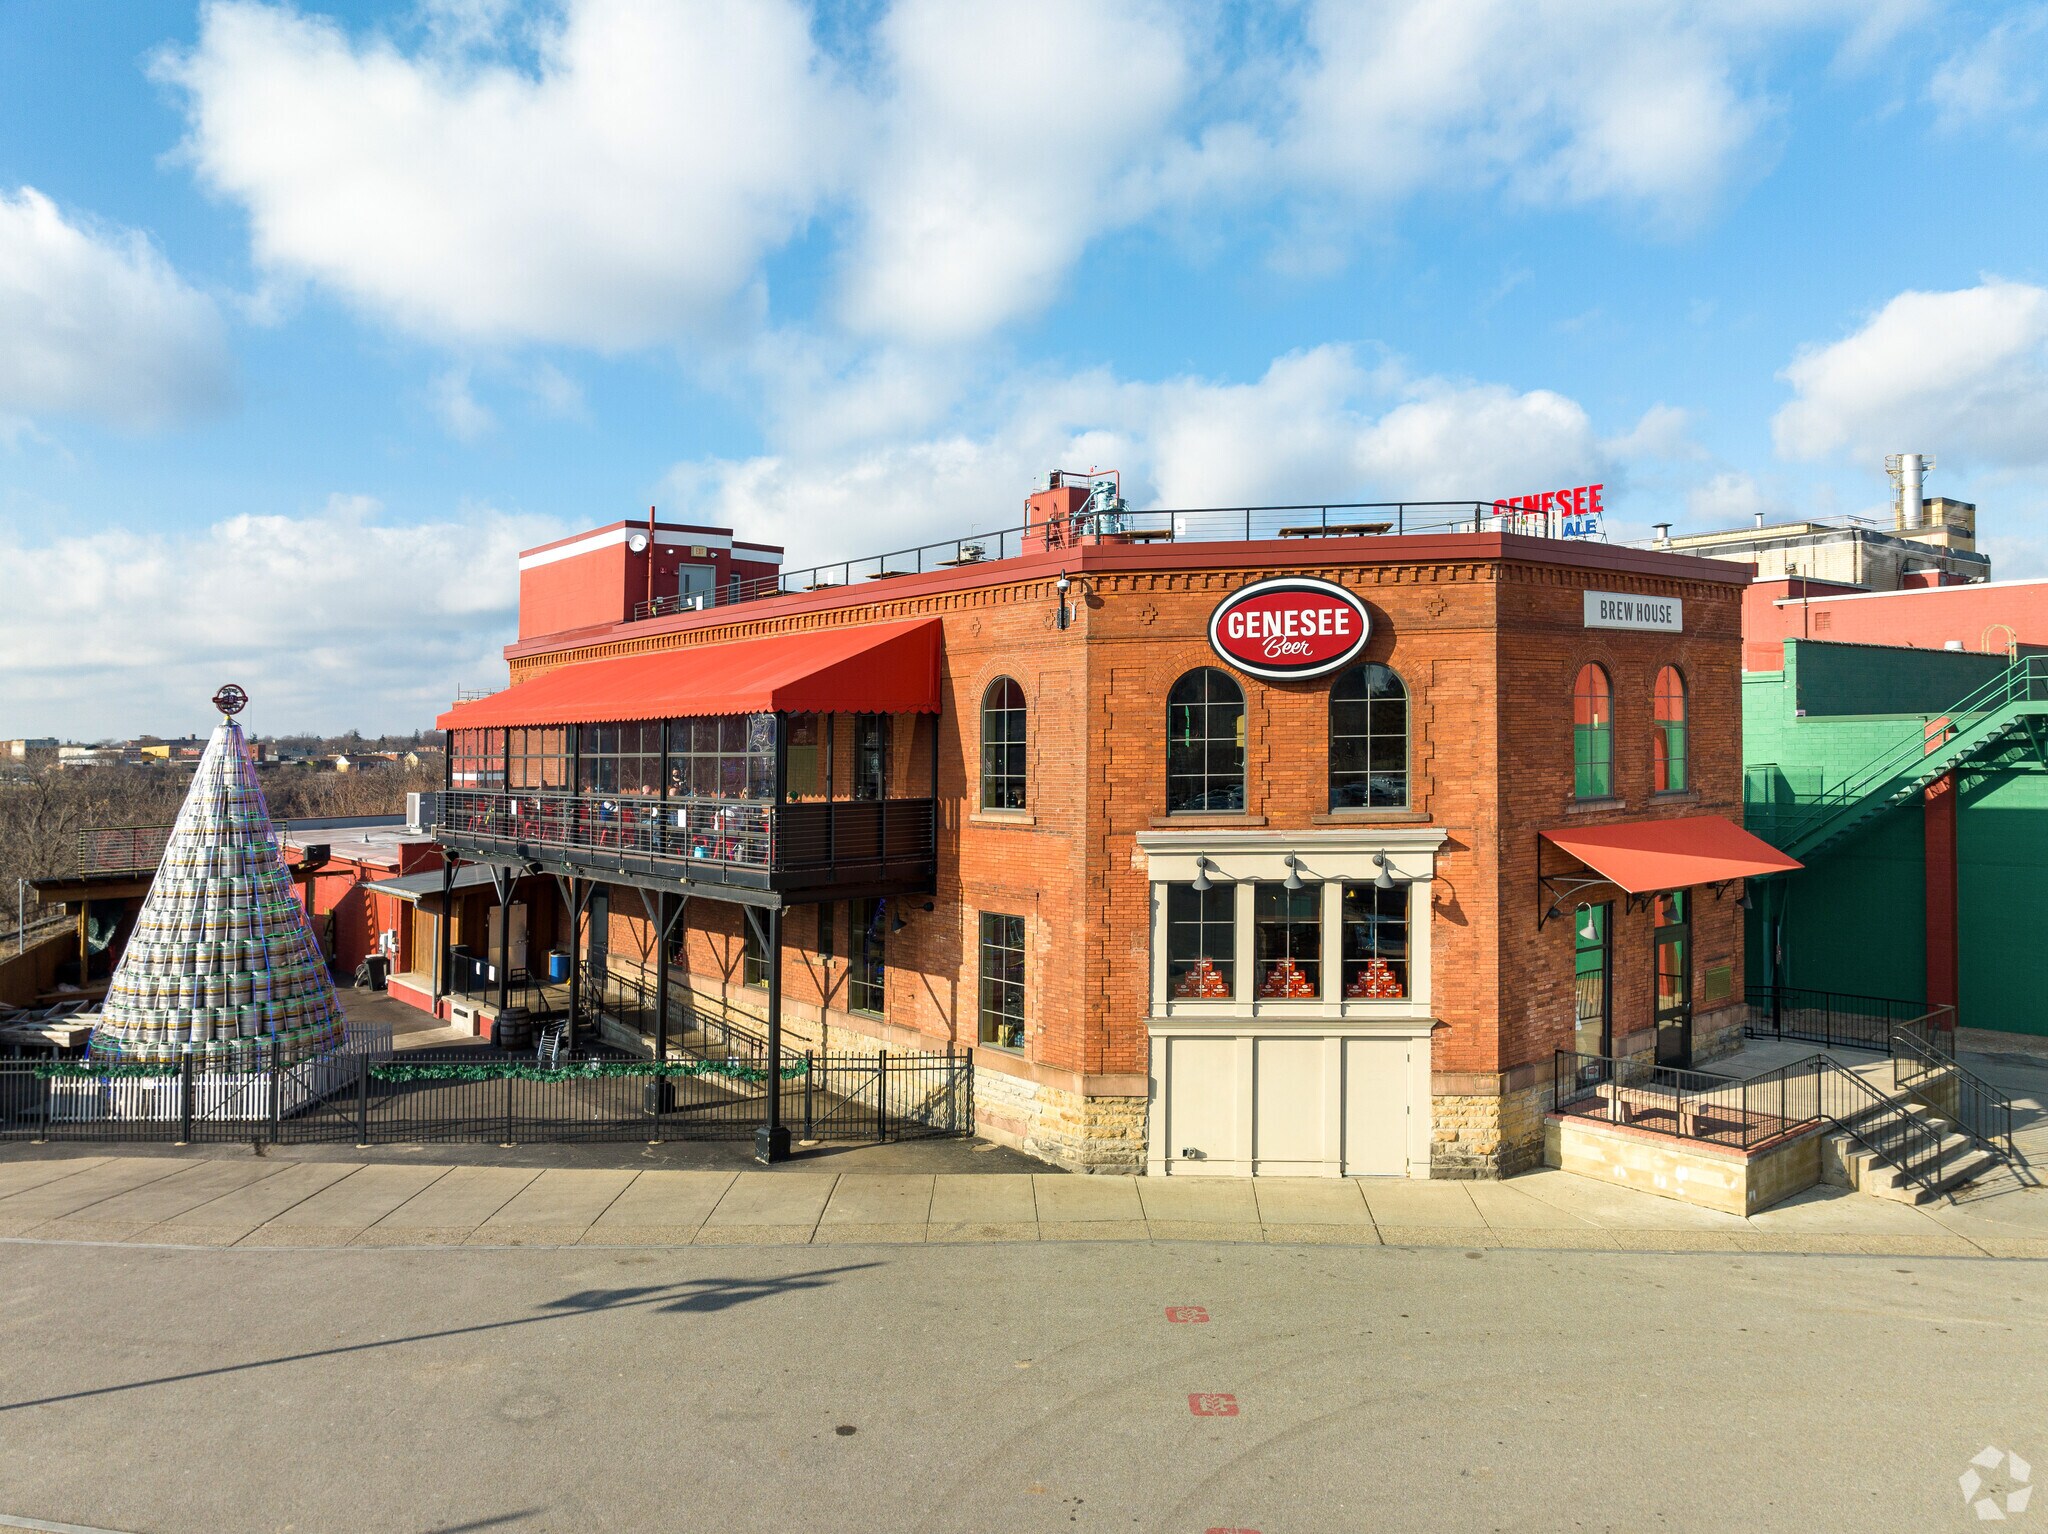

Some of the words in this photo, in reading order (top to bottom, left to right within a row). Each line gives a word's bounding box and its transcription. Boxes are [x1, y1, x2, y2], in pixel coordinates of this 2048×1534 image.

[1563, 519, 1597, 537] ALE
[1227, 608, 1350, 639] GENESEE
[1600, 599, 1633, 621] BREW
[1636, 603, 1672, 624] HOUSE
[1262, 633, 1313, 658] Beer
